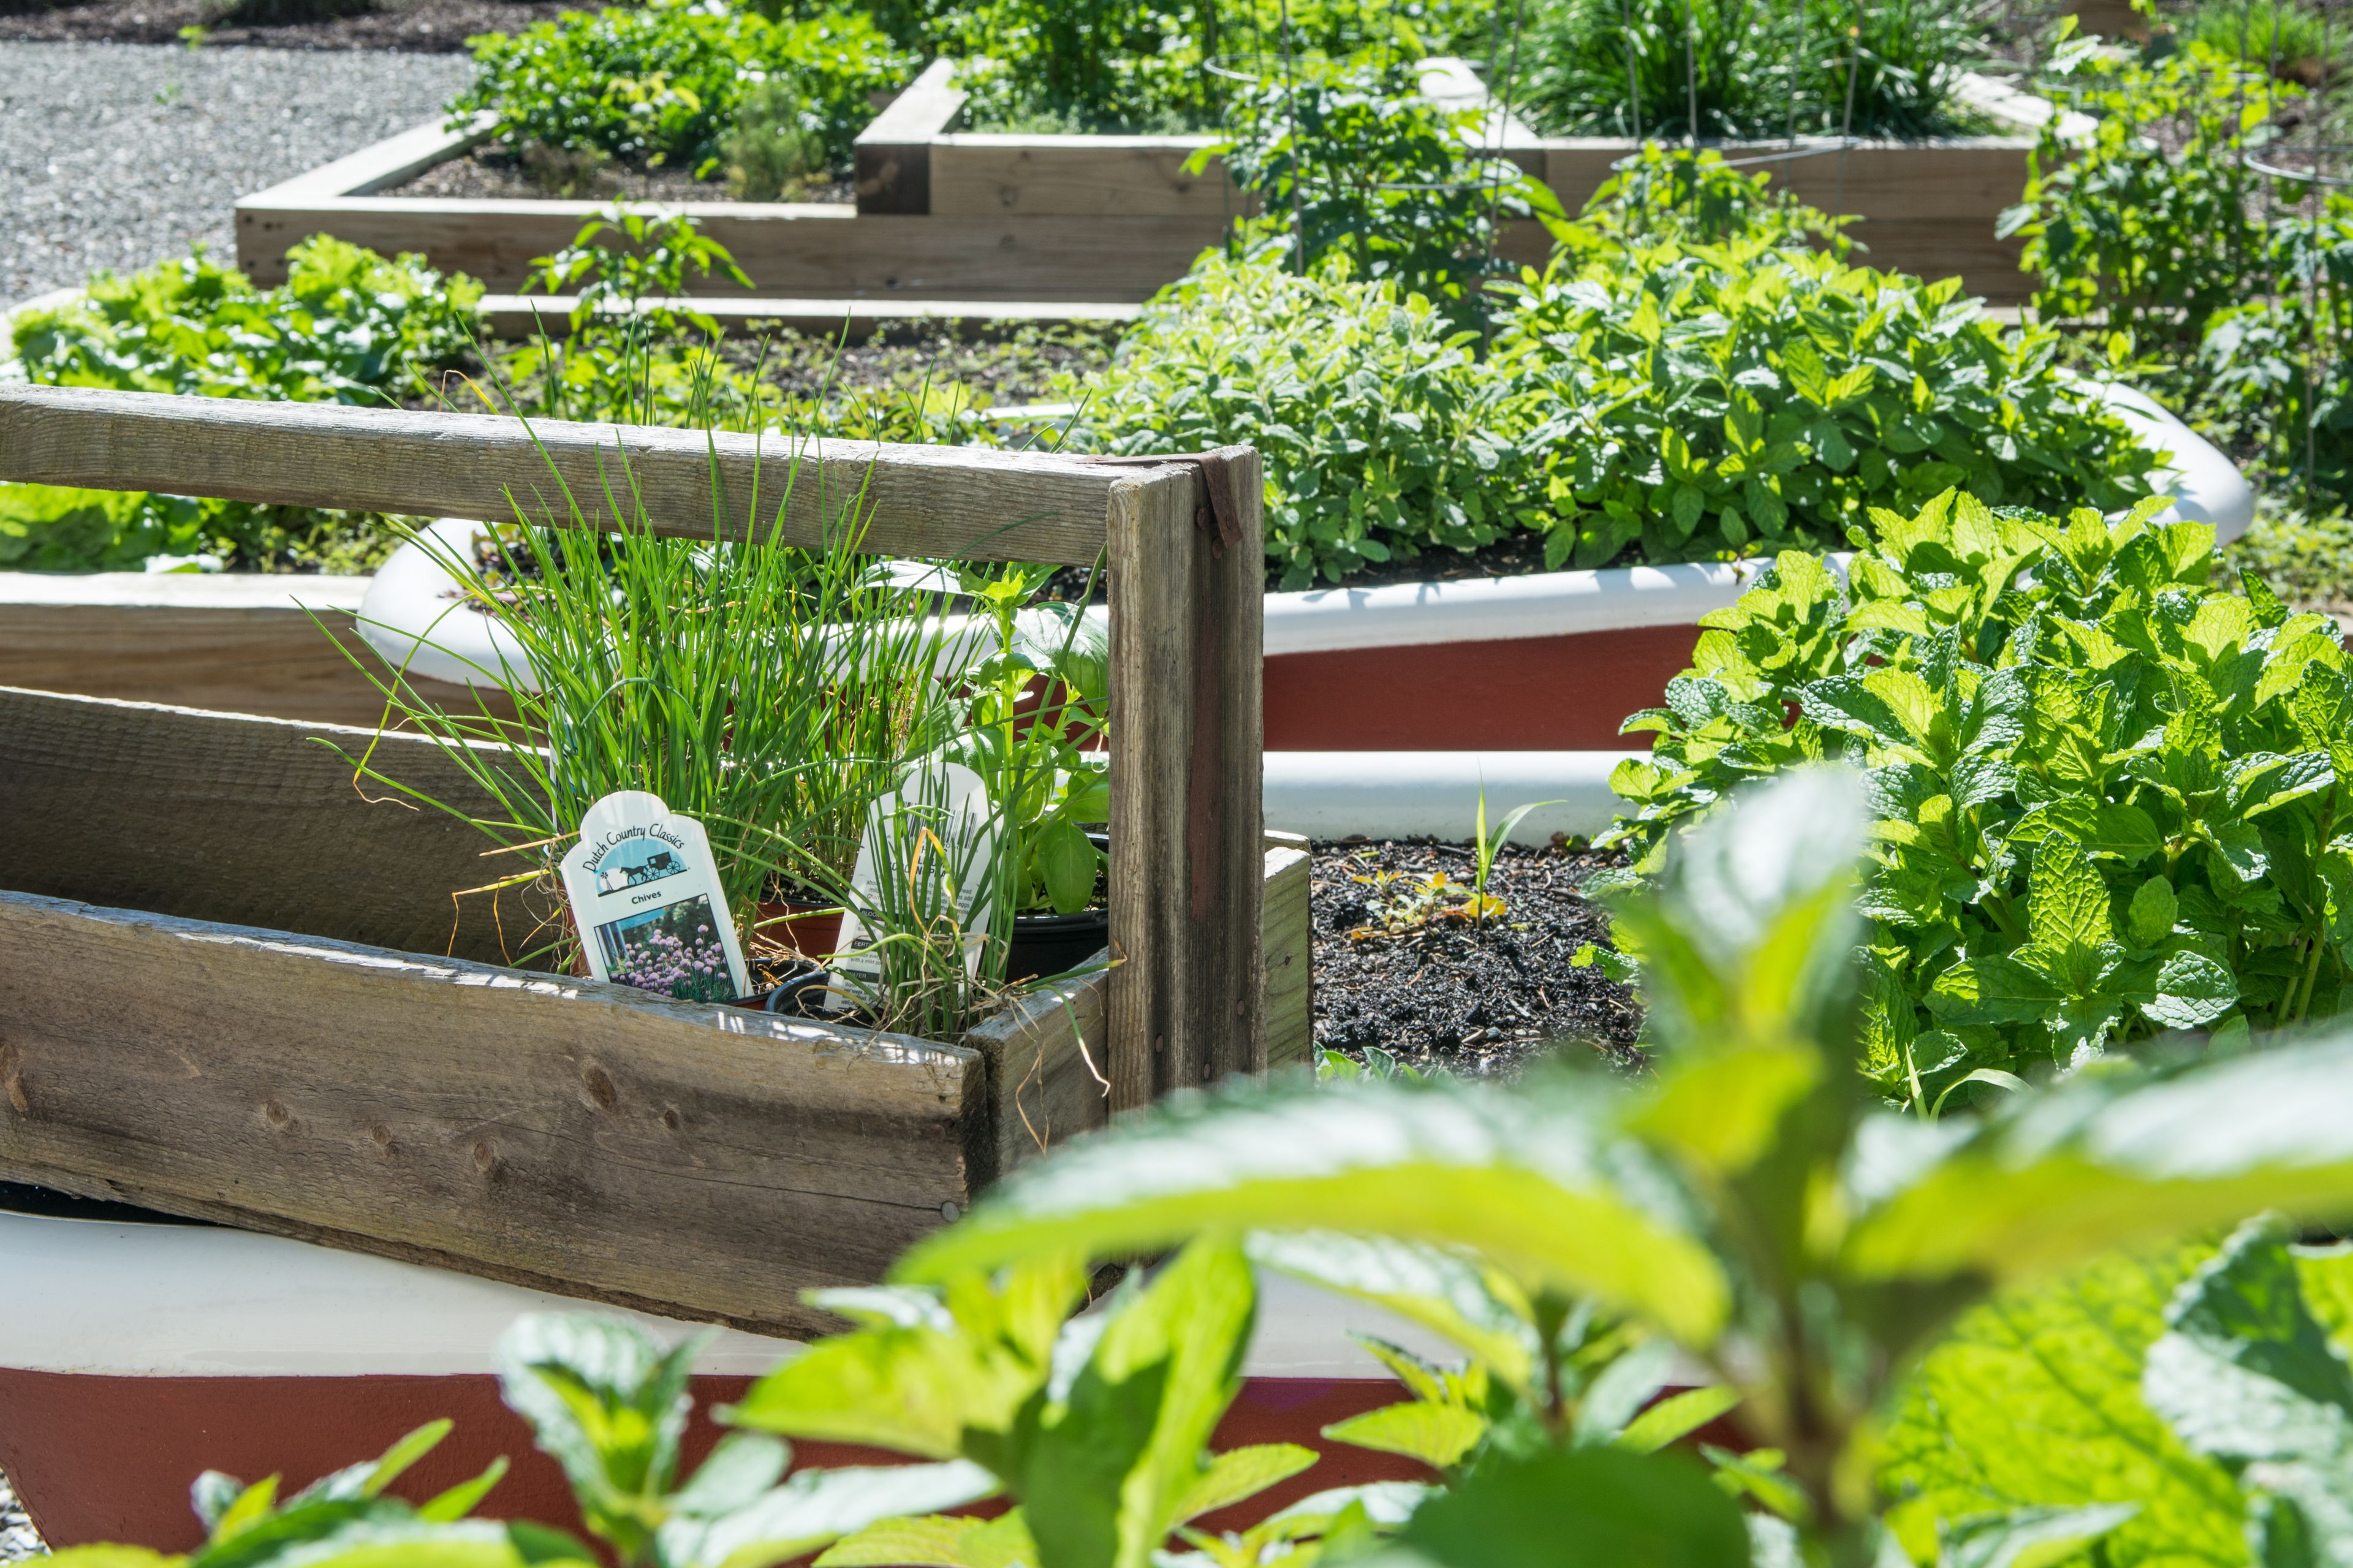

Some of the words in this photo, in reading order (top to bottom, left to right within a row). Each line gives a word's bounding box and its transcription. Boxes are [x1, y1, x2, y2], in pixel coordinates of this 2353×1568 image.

[583, 842, 608, 872] Dutch
[607, 825, 645, 845] Country
[650, 824, 685, 849] Classics
[631, 891, 662, 904] Chives
